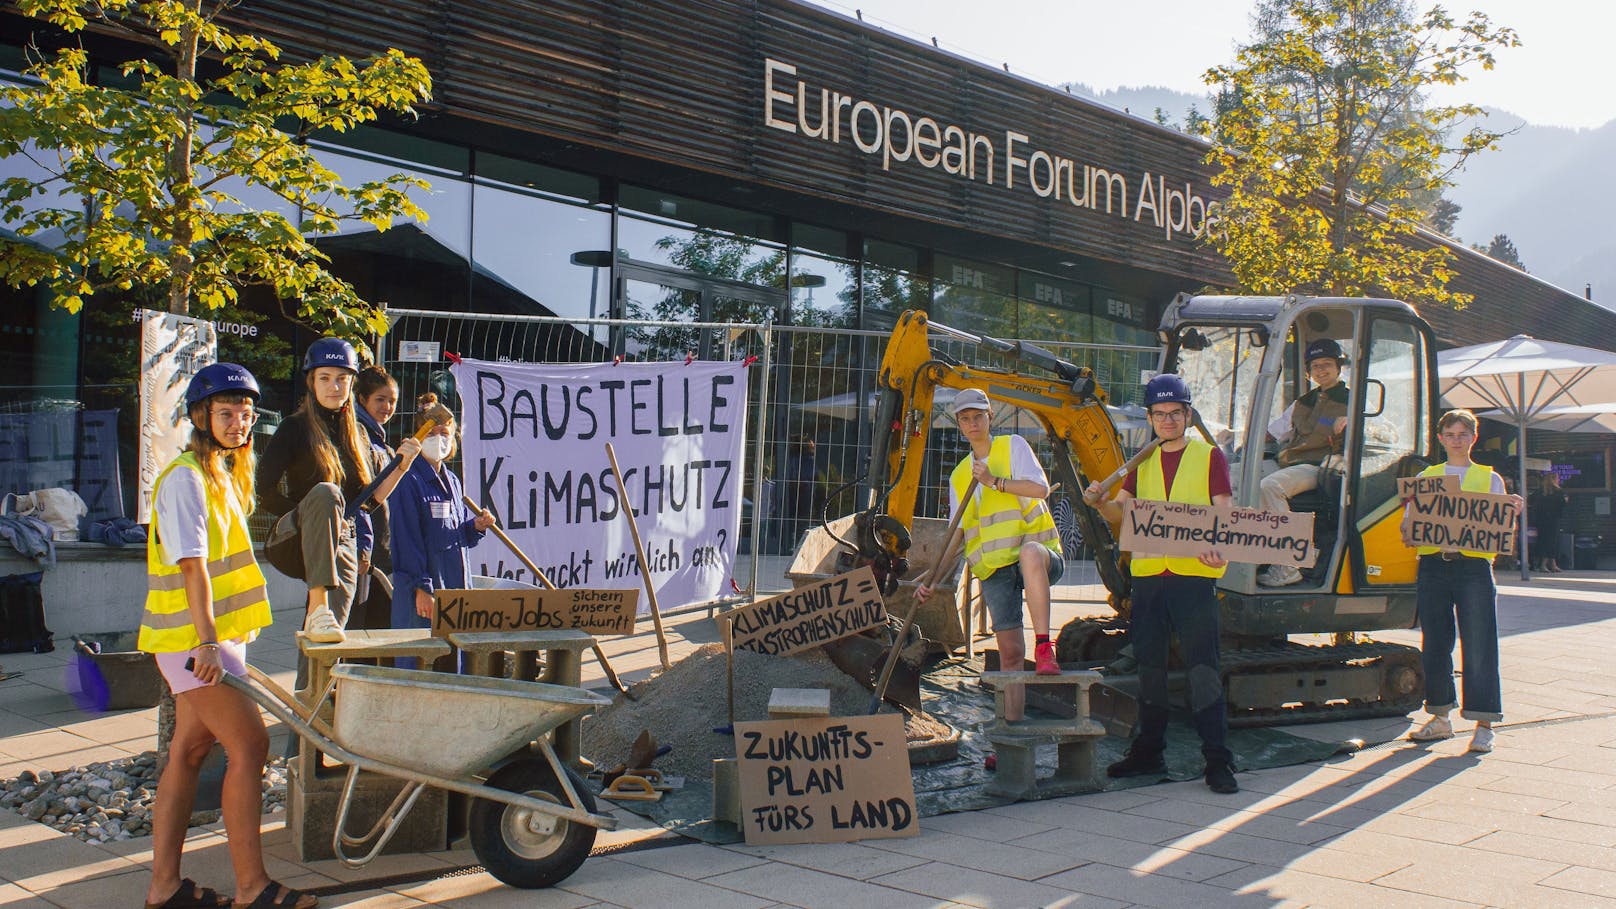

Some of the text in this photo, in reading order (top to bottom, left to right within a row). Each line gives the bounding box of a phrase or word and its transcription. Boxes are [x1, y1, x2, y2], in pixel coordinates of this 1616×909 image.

[765, 58, 1229, 241] European Forum Alpba
[952, 264, 985, 289] EFA
[1035, 282, 1063, 305] EFA
[1107, 298, 1132, 319] EFA
[477, 371, 734, 440] BAUSTELLE
[1403, 477, 1447, 494] MEHR
[1132, 500, 1289, 530] Wir wollen günstige
[1130, 510, 1310, 562] Wärmedämmung
[1412, 520, 1513, 553] ERDWÄRME
[604, 538, 680, 580] wirklich
[572, 603, 622, 613] unsere
[573, 590, 623, 602] sichern
[731, 578, 854, 639] KLIMASCHUTZ
[436, 597, 563, 630] Klima-Jobs
[571, 615, 630, 629] Zukunft
[734, 599, 887, 656] TASTROPHENSCHUTZ
[743, 725, 884, 761] ZUKUNFTS-
[767, 764, 844, 796] PLAN
[752, 797, 912, 832] FÜRS LAND
